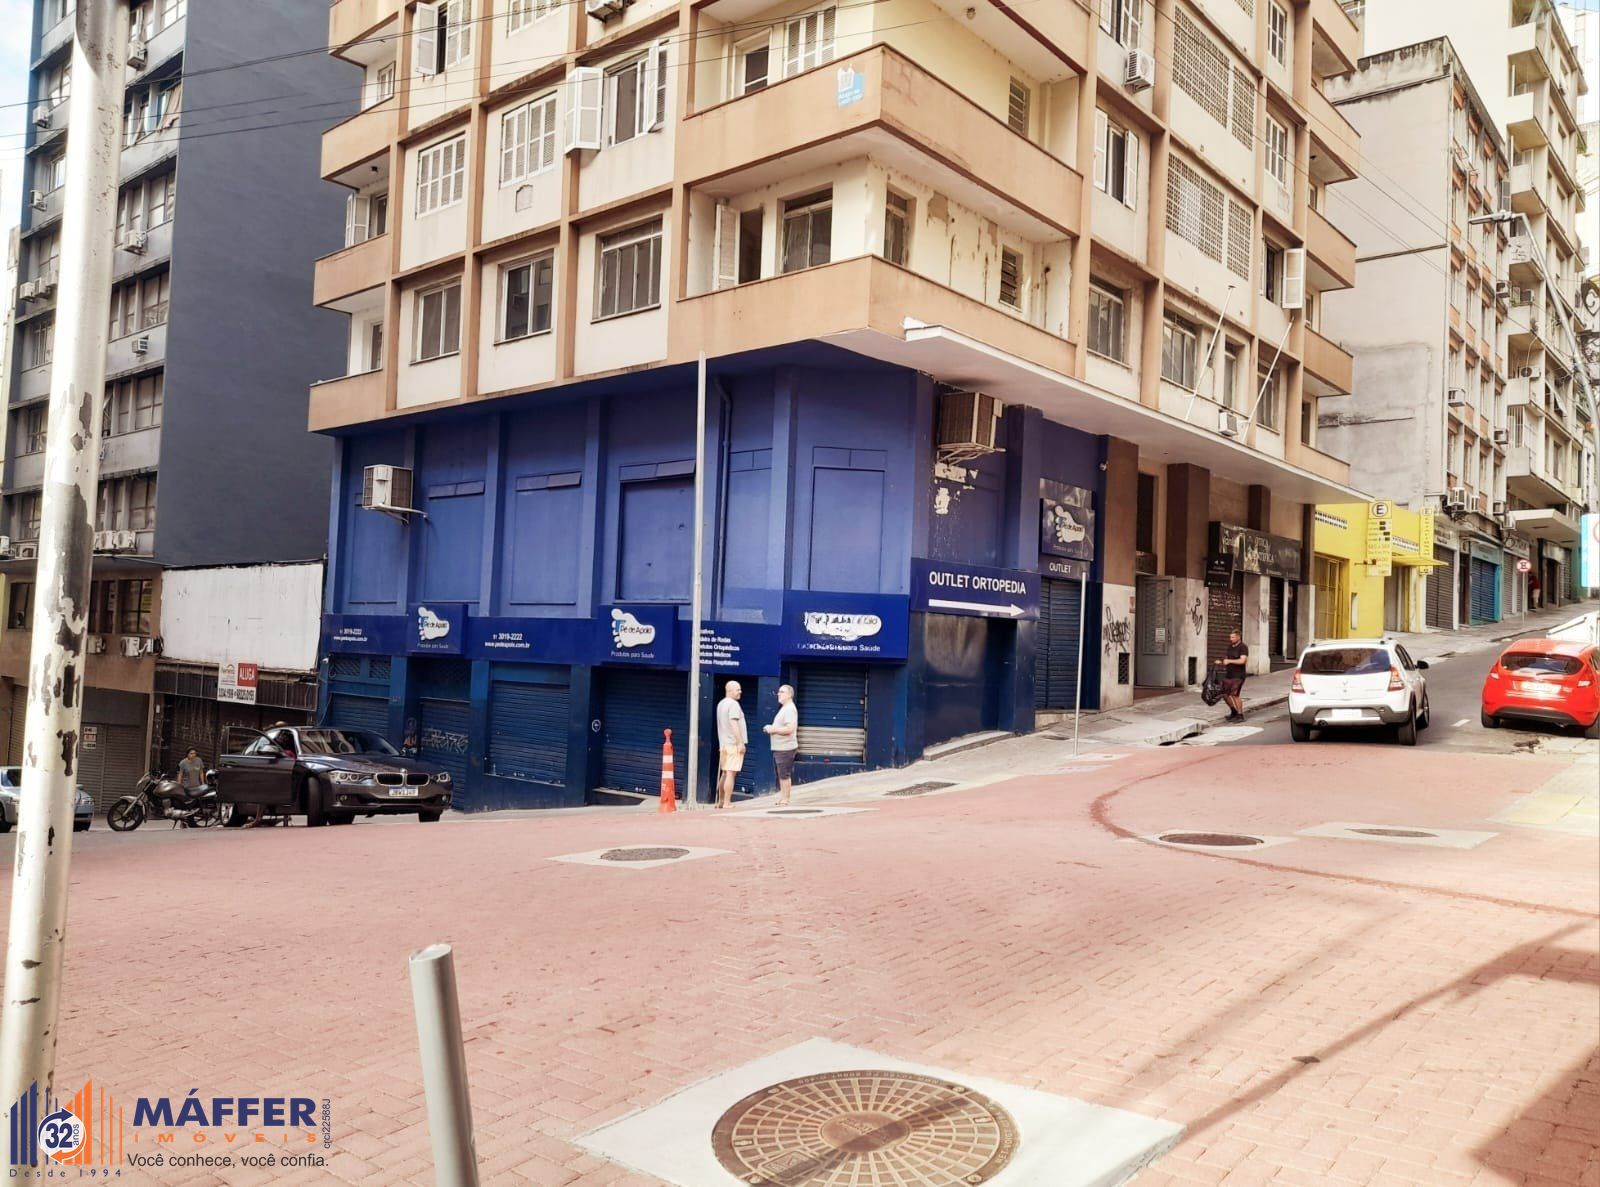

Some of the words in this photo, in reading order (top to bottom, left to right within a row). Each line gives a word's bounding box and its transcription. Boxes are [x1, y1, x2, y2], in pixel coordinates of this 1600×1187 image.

[1049, 562, 1072, 574] OUTLET
[929, 571, 970, 588] OUTLET
[972, 576, 1026, 594] ORTOPEDIA
